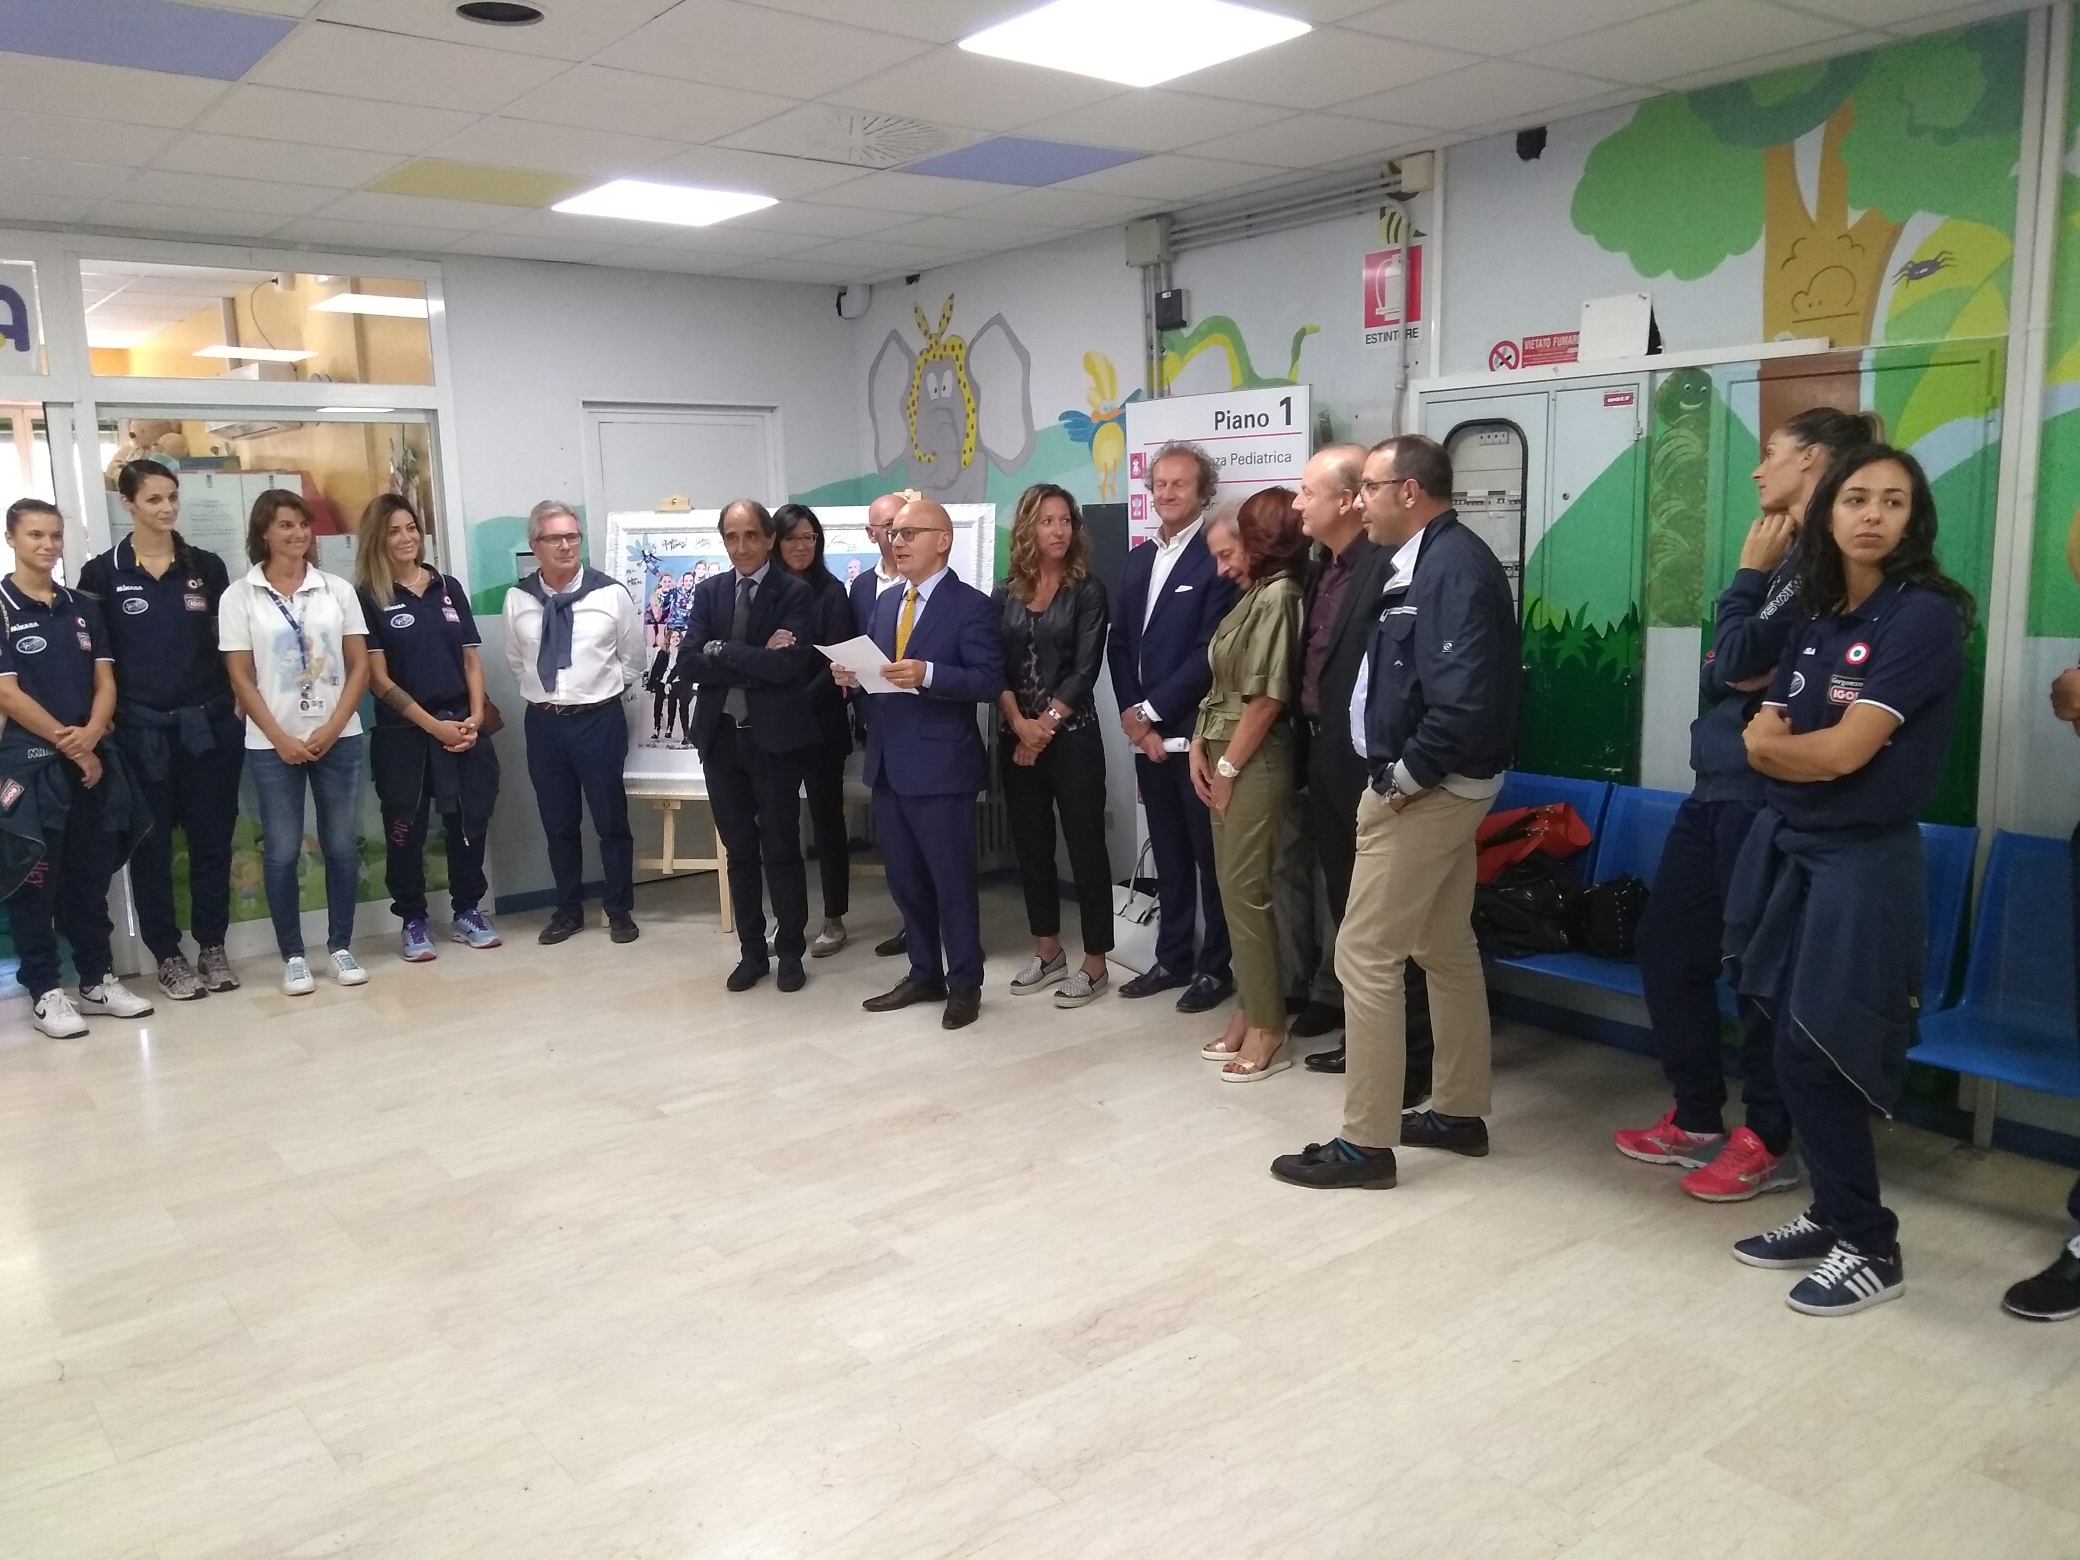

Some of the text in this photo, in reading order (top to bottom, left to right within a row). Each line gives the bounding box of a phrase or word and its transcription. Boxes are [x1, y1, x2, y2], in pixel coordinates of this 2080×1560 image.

[1365, 327, 1419, 345] ESTINTRE
[1524, 337, 1551, 350] VIETATO
[1214, 396, 1291, 430] Piano 1
[1230, 450, 1292, 465] Pediatrica
[10, 621, 39, 633] MIKASA
